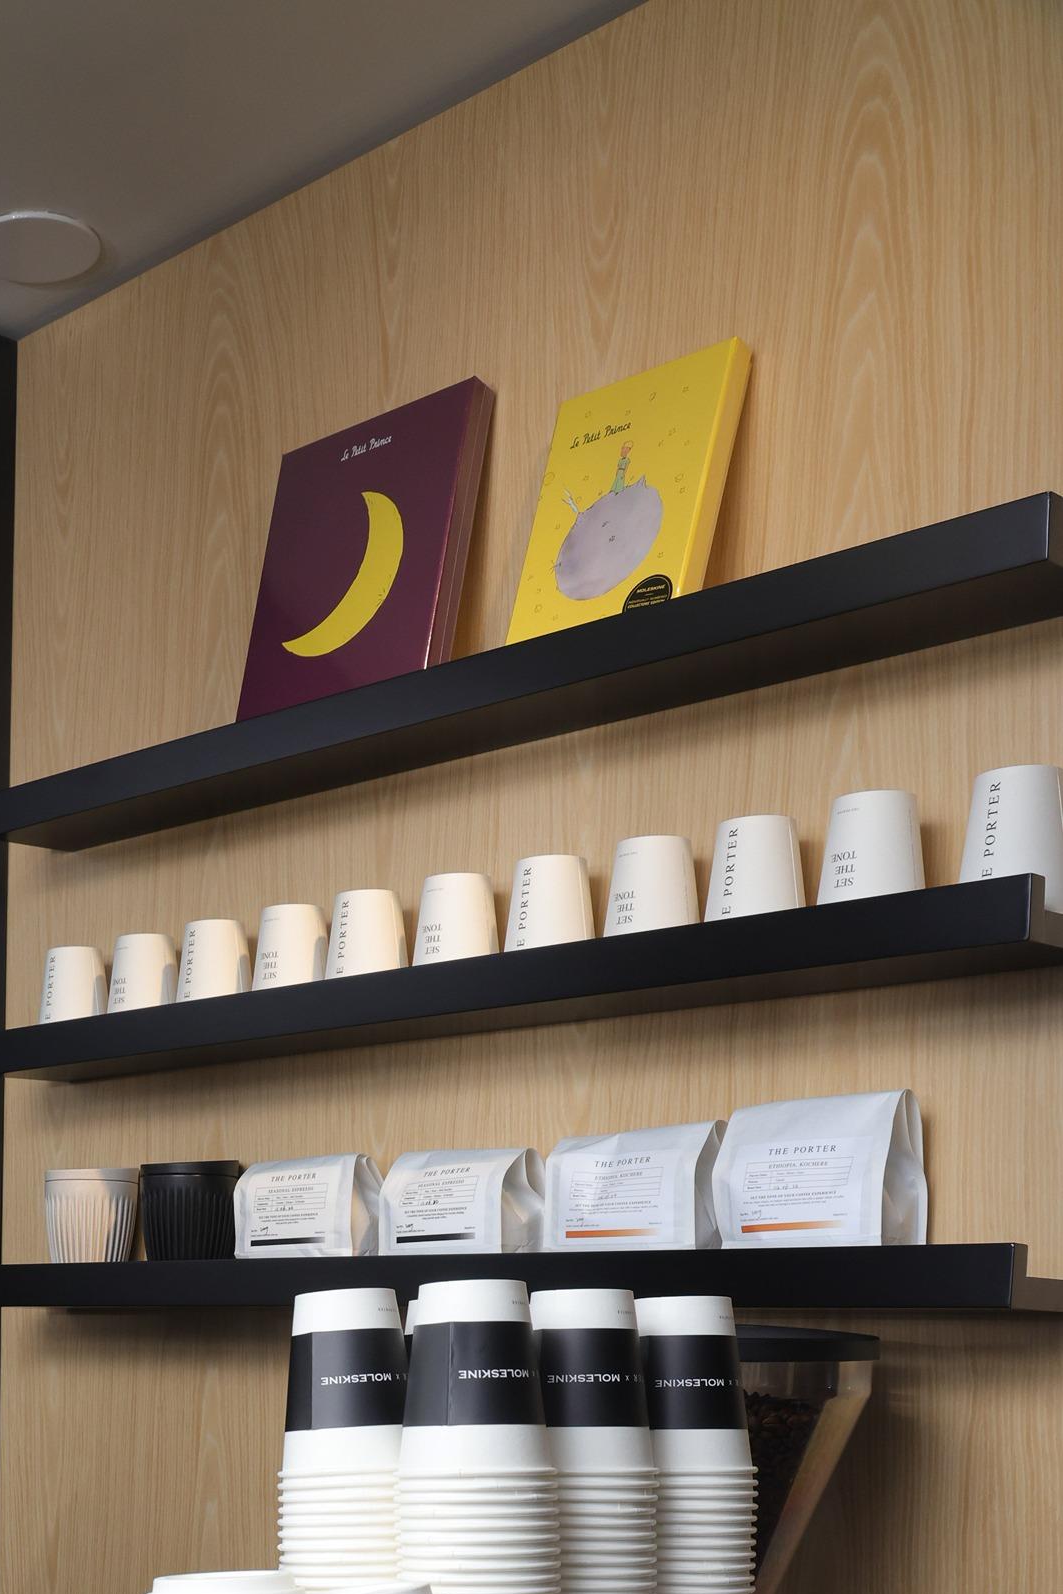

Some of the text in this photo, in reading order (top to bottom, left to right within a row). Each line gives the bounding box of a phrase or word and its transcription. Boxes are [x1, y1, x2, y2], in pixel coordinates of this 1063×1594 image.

[569, 422, 631, 449] Le Petit Prince
[983, 781, 1001, 857] PORTER
[723, 828, 738, 897] PORTER
[831, 850, 857, 863] TONE
[835, 863, 855, 875] THE
[834, 877, 854, 889] SET
[518, 867, 532, 930] PORTER
[617, 902, 634, 913] THE
[617, 914, 633, 925] SET
[338, 900, 349, 959] PORTER
[185, 929, 195, 984] PORTER
[46, 956, 55, 1007] PORTER
[768, 1144, 837, 1156] THE PORTER
[595, 1156, 651, 1168] THE PORTER
[287, 1173, 317, 1181] PORTER
[440, 1167, 471, 1175] PORTER
[320, 1372, 392, 1386] MOLESKINE
[458, 1369, 529, 1379] MOLESKINE
[547, 1373, 620, 1384] MOLESKINE
[655, 1378, 725, 1388] MOLESKINE
